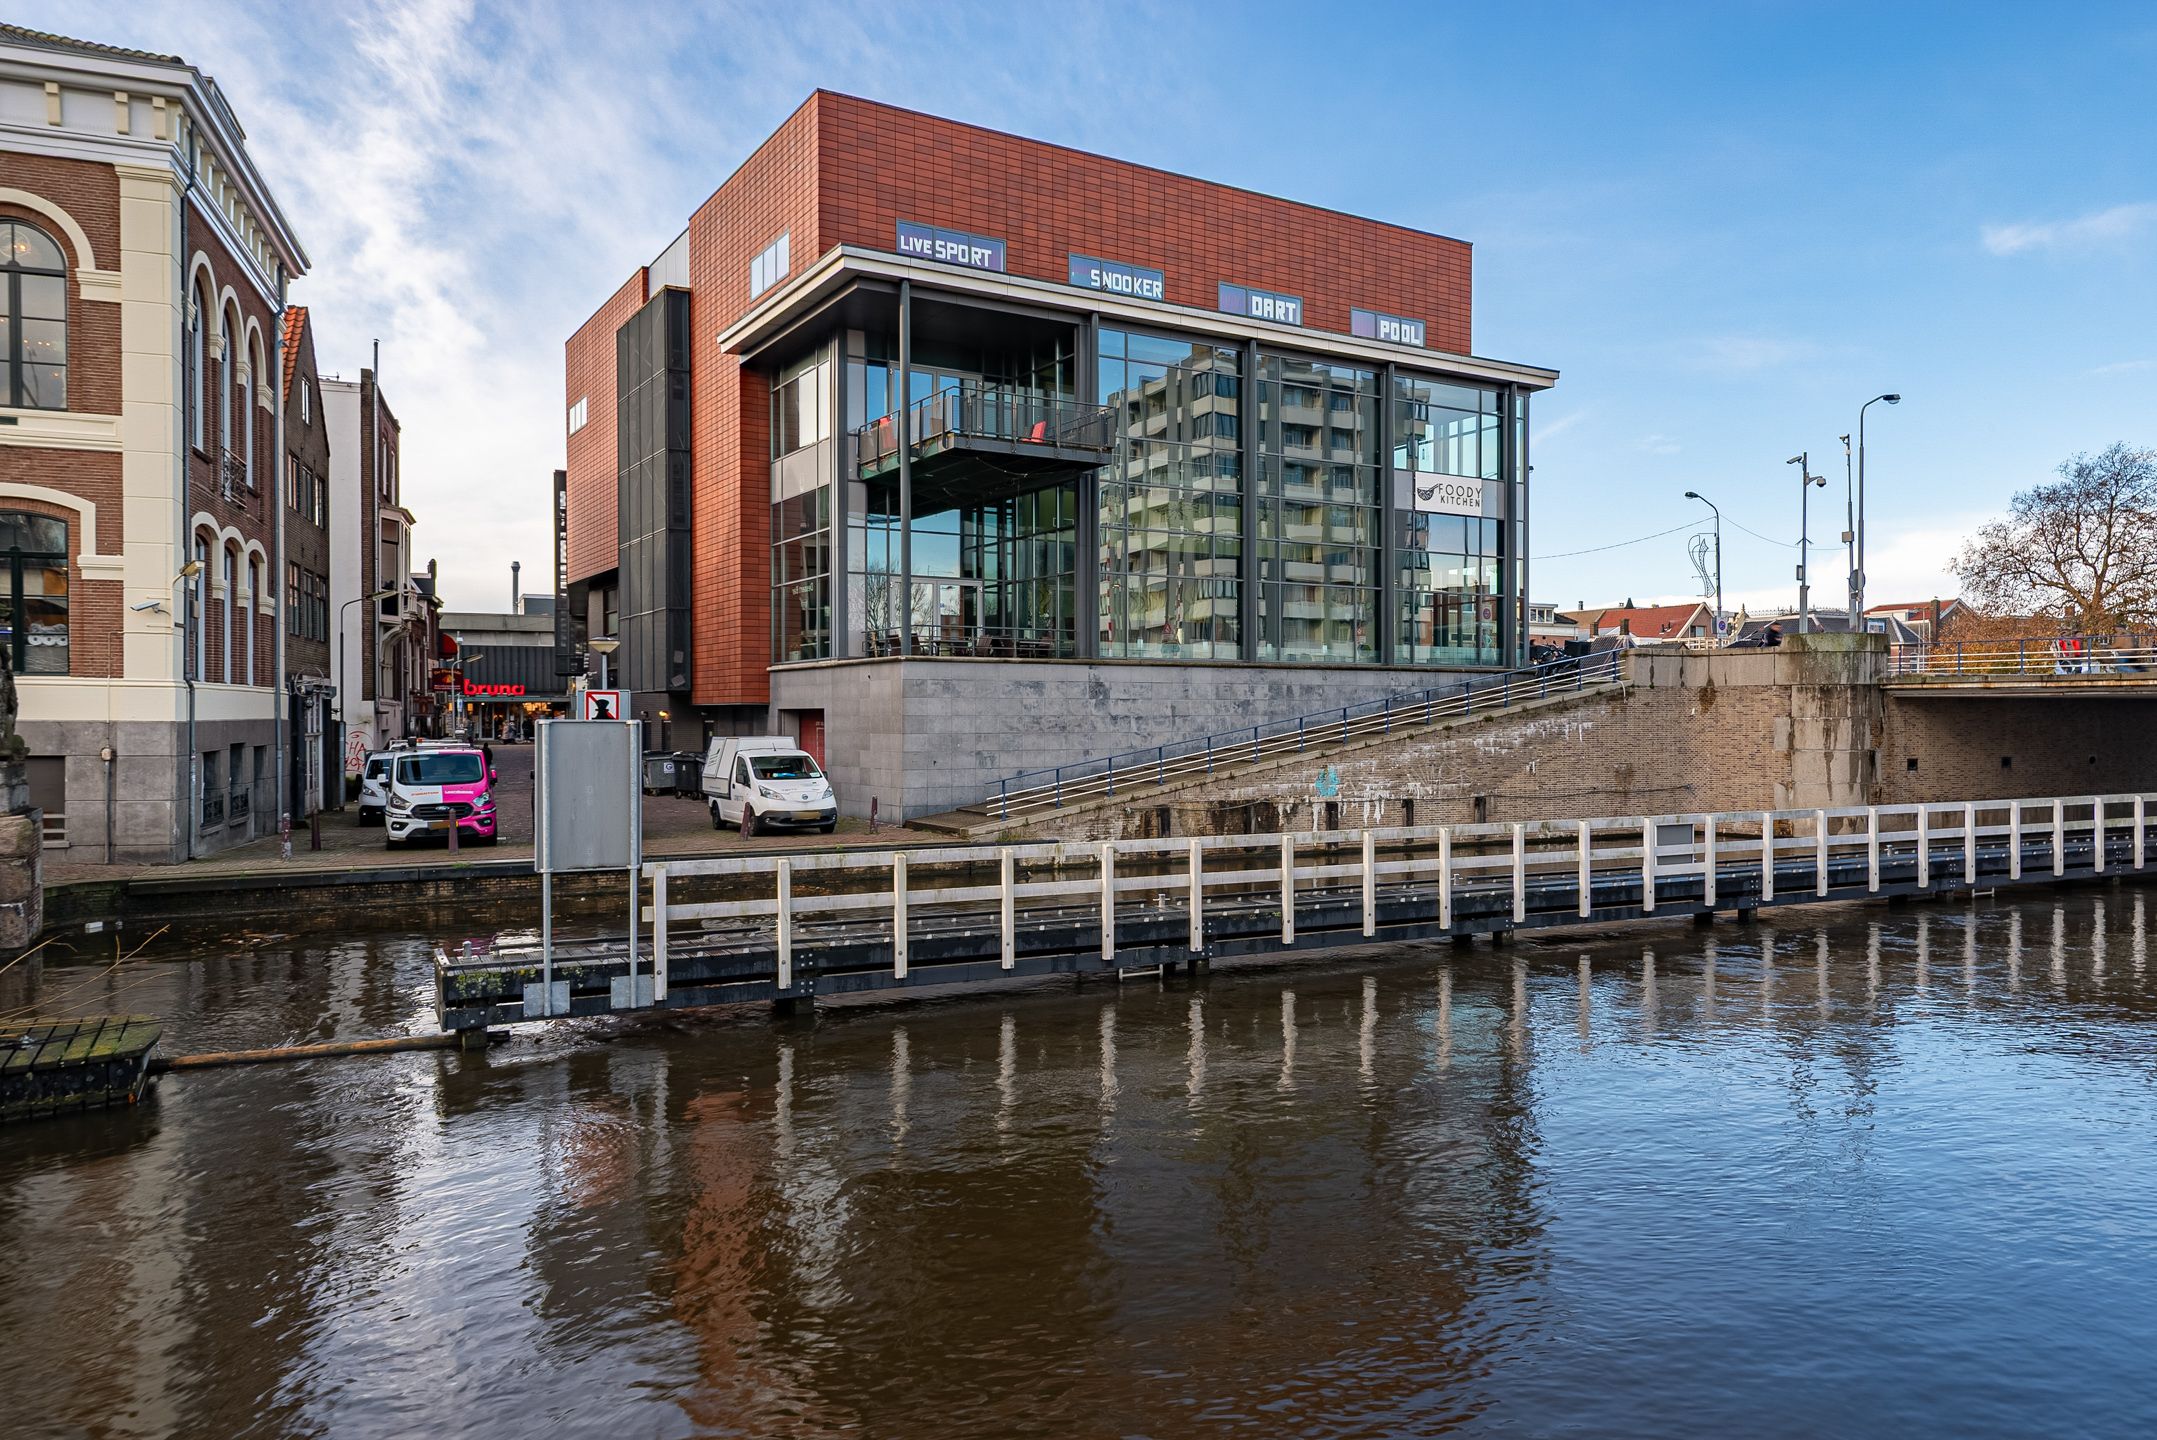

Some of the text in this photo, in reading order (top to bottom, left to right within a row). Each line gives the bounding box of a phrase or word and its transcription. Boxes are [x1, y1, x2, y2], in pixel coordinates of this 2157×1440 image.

[900, 235, 992, 267] LIVE SPORT
[1090, 269, 1162, 298] SNOOKER
[1251, 296, 1296, 321] DART
[1380, 320, 1421, 344] POOL
[1438, 483, 1482, 498] FOODY
[1440, 496, 1480, 507] KITCHEN
[463, 678, 525, 697] bruna
